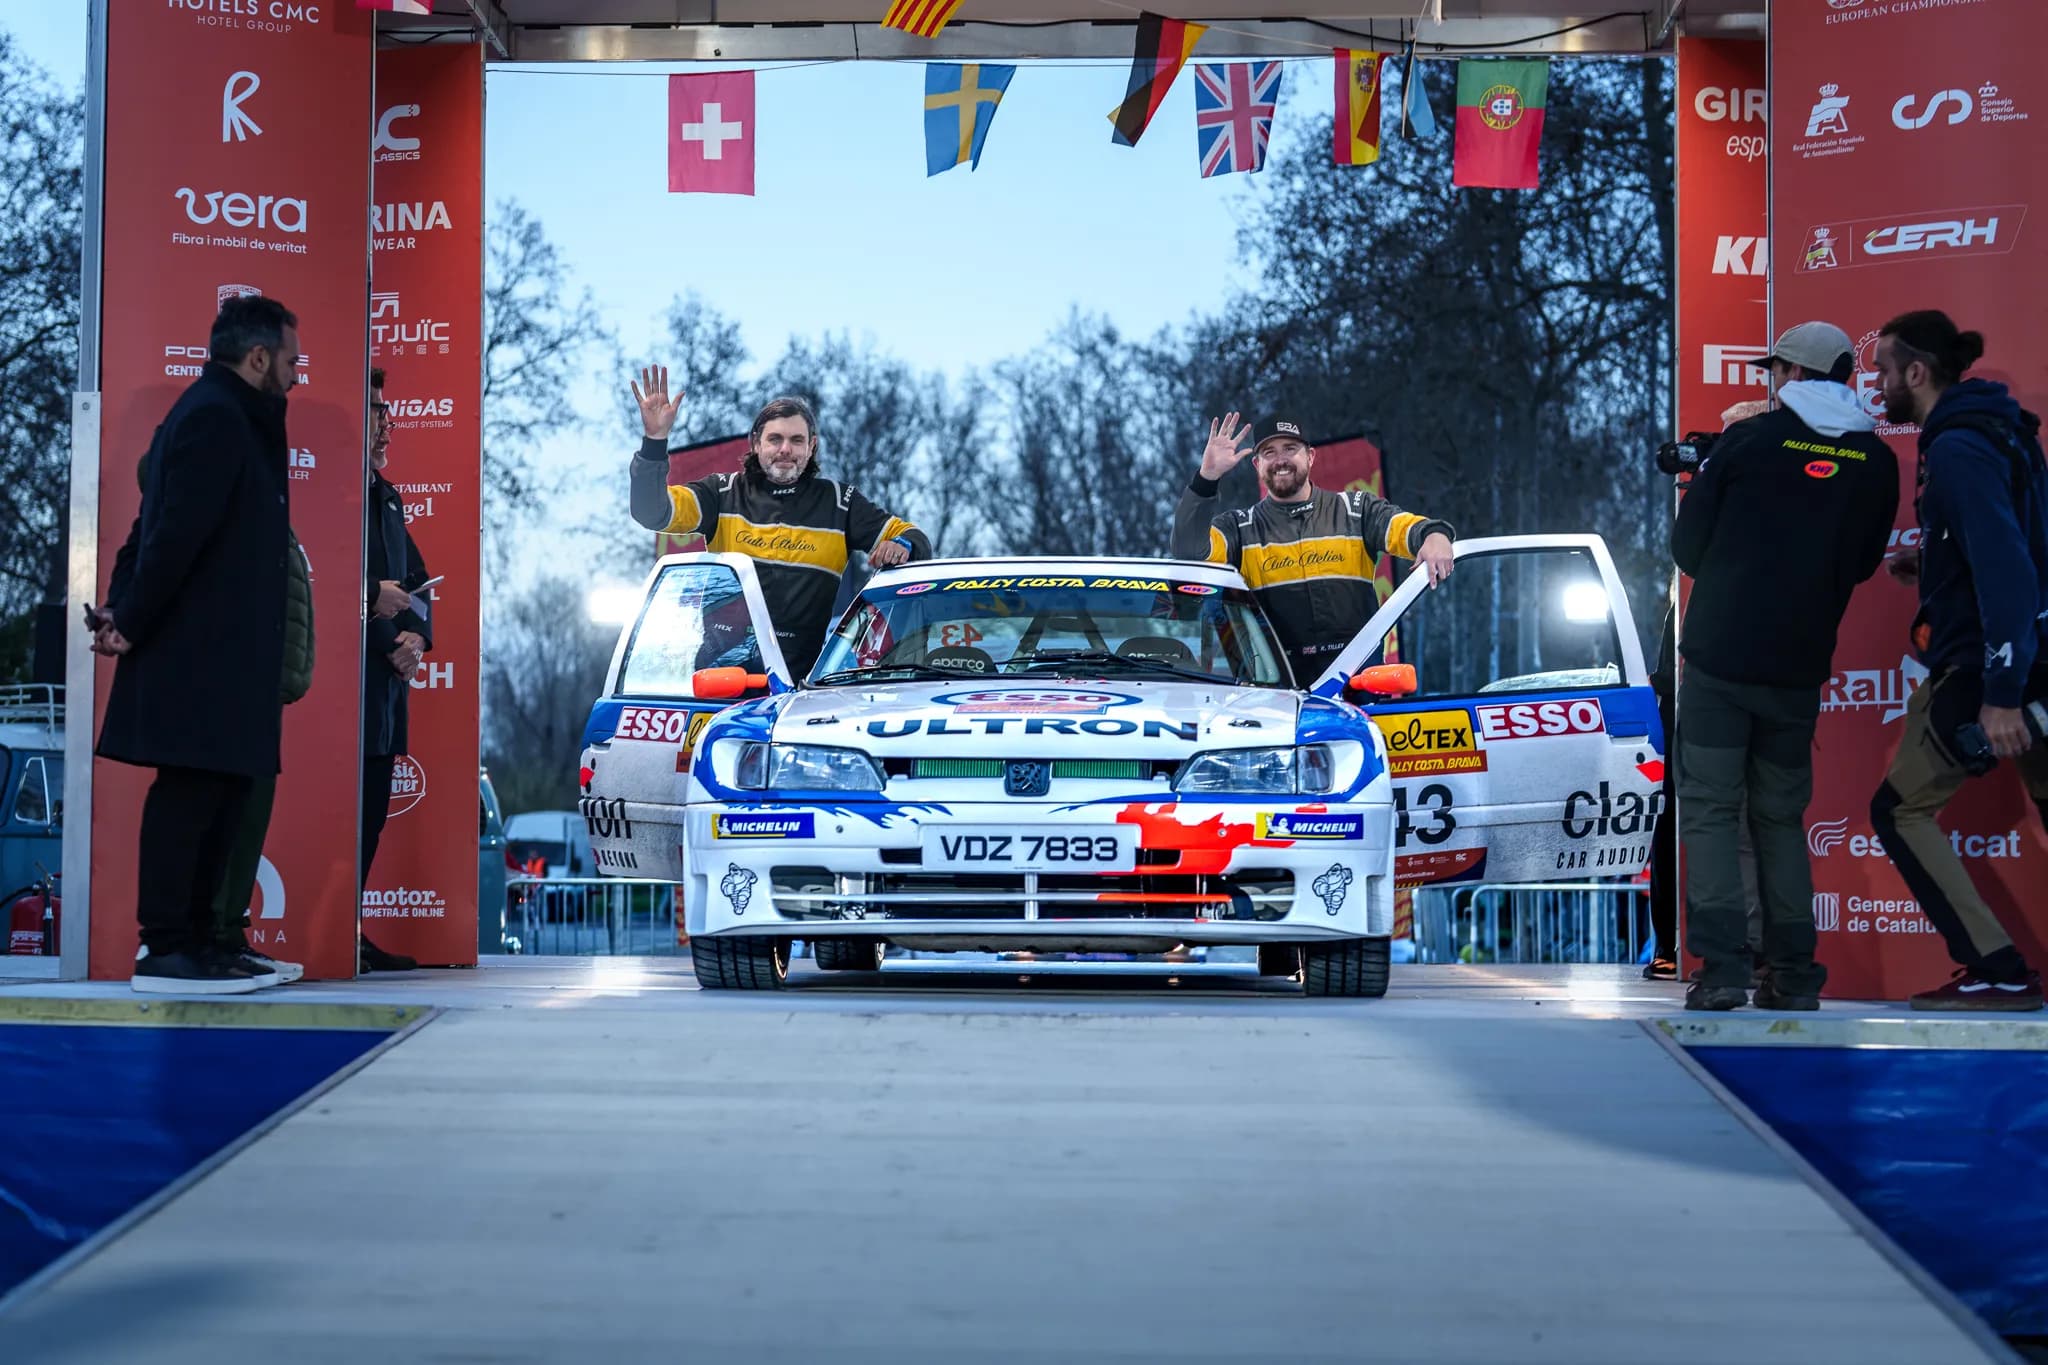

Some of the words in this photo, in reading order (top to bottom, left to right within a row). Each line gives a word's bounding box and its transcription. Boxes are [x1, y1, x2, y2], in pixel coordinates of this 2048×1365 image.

[269, 2, 320, 23] CMC
[1825, 5, 1888, 24] EUROPEAN
[197, 15, 240, 29] HOTEL
[246, 20, 292, 33] GROUP
[1981, 98, 2013, 107] Consejo
[1982, 106, 2014, 115] Superior
[1993, 113, 2028, 121] Deportes
[175, 187, 308, 233] vera
[172, 232, 204, 245] Fibra
[207, 235, 210, 244] i
[213, 236, 247, 249] mòbil
[250, 240, 265, 250] de
[268, 242, 307, 255] veritat
[943, 578, 1017, 591] RALLY
[1017, 578, 1086, 588] COSTA
[1089, 579, 1171, 591] BRAVA
[966, 693, 1112, 703] ESSO
[615, 709, 686, 741] ESSO
[1481, 701, 1601, 738] ESSO
[867, 717, 1199, 742] ULTRON
[1414, 758, 1446, 772] COSTA
[1446, 755, 1482, 769] BRAVA
[731, 821, 801, 833] MICHELIN
[1292, 822, 1357, 833] MICHELIN
[940, 835, 1012, 861] VDZ
[1021, 836, 1118, 861] 7833
[1556, 851, 1588, 869] CAR
[1596, 845, 1646, 867] AUDIO
[411, 907, 445, 918] ONLINE
[1847, 917, 1870, 933] de
